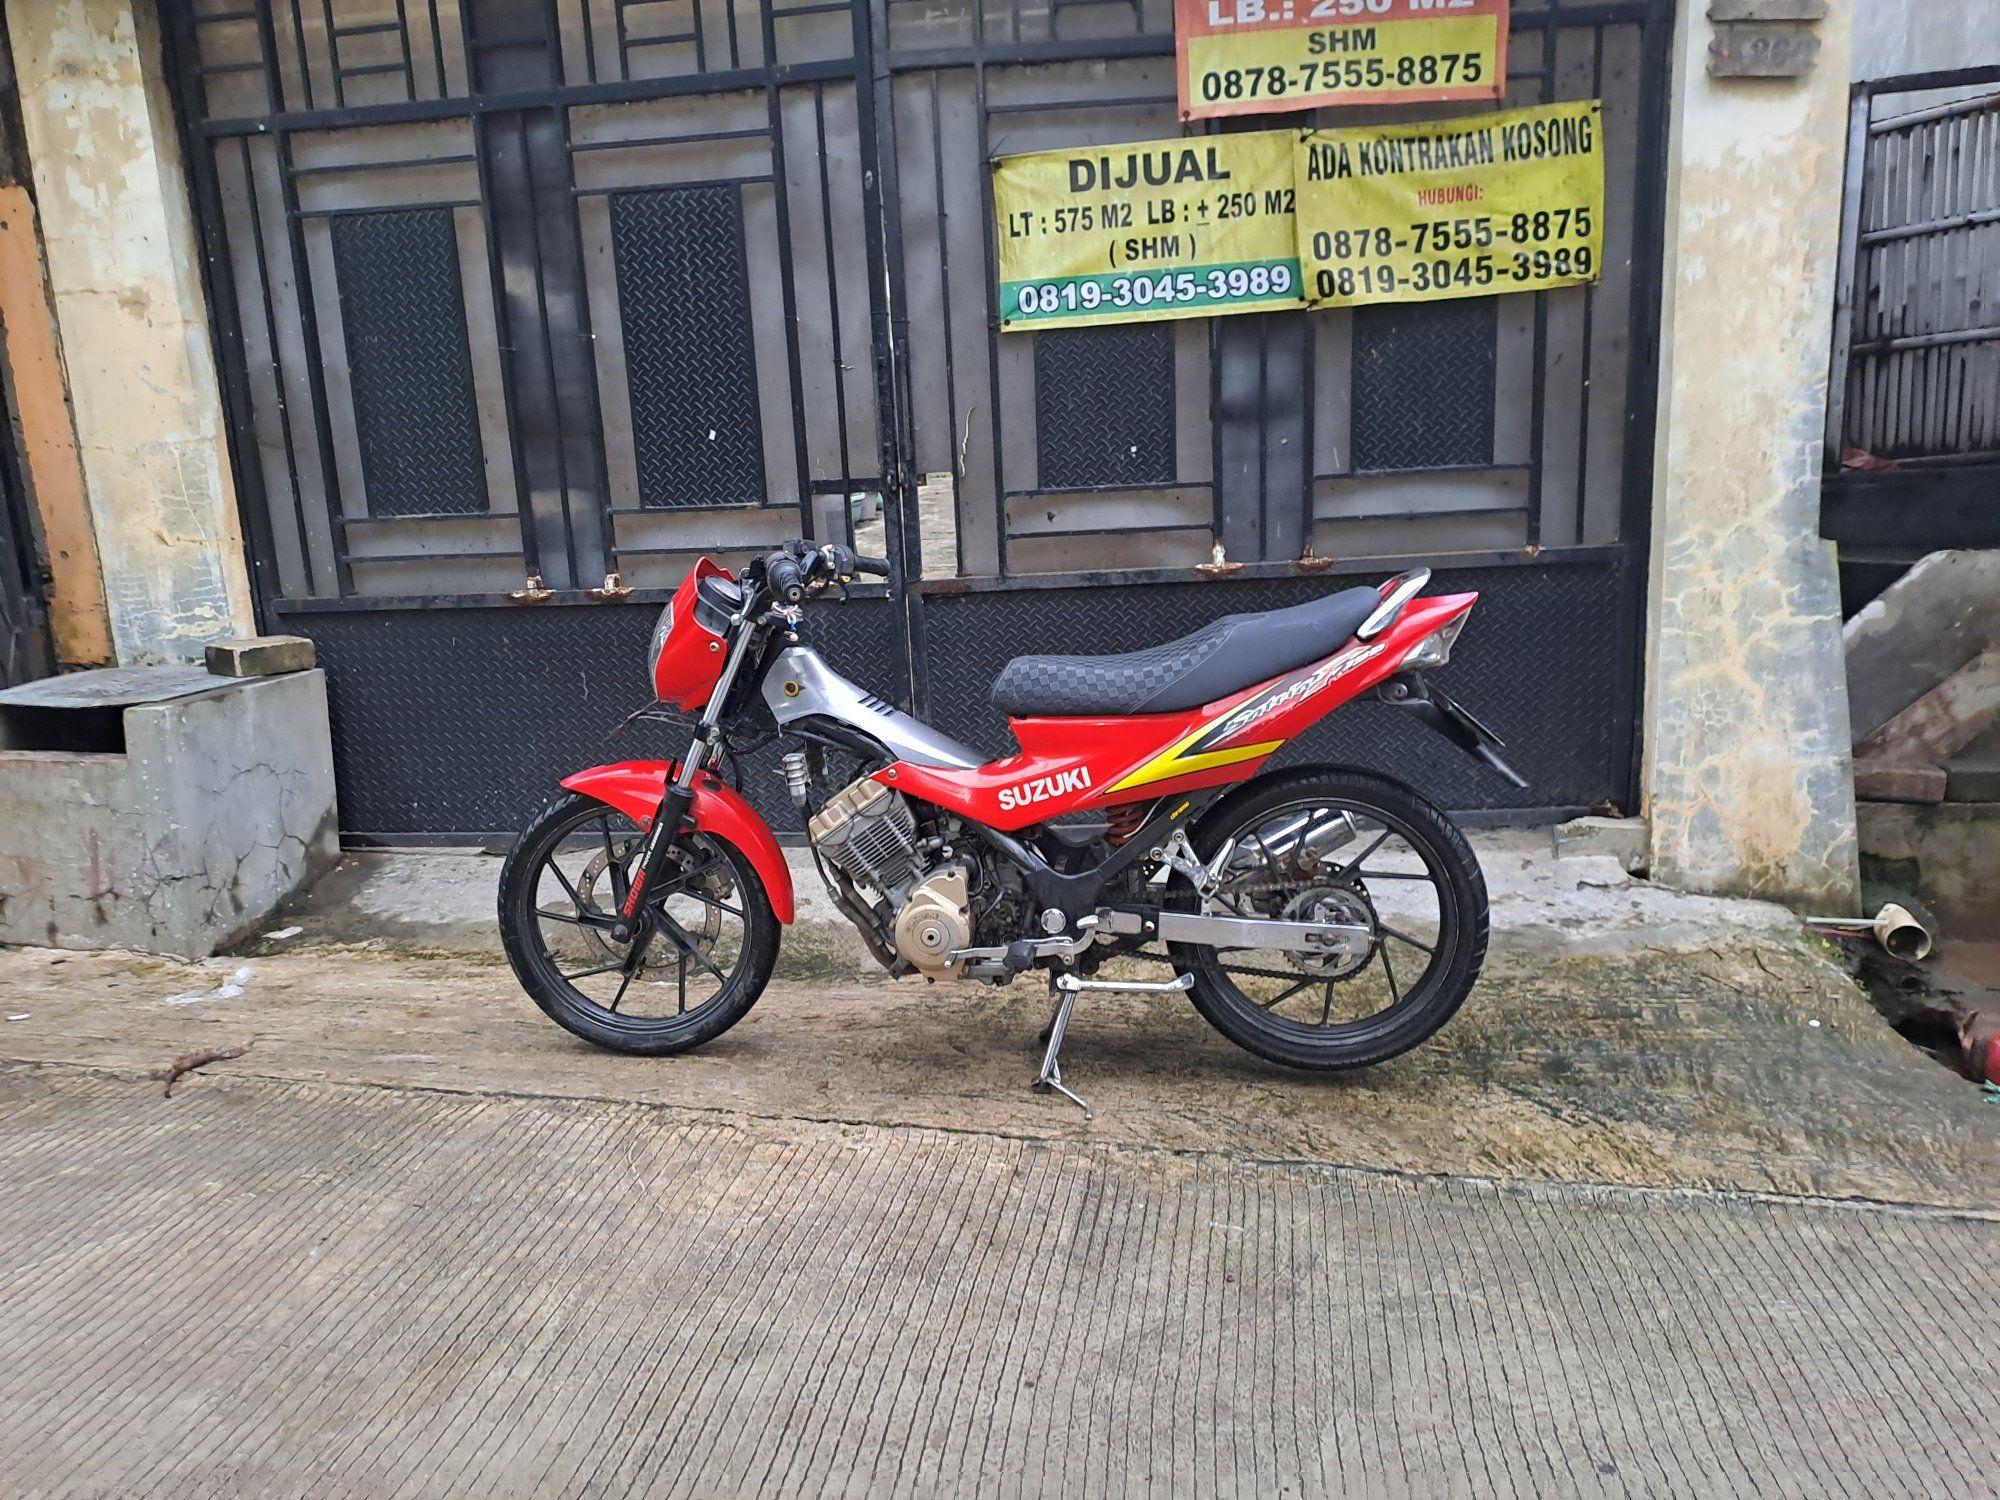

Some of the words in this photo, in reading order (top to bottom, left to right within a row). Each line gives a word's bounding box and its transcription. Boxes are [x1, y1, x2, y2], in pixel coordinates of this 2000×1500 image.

[1308, 27, 1376, 55] SHM
[1202, 53, 1482, 101] 0878-7555-8875
[1069, 147, 1231, 193] DIJUAL
[1308, 142, 1352, 181] ADA
[1358, 128, 1495, 176] KONTRAKAN
[1502, 115, 1593, 162] KOSONG
[1054, 205, 1093, 233] 575
[1101, 202, 1133, 230] M2
[1217, 192, 1257, 219] 250
[1265, 188, 1296, 215] M2
[1417, 184, 1484, 206] HUBUNGI:
[1313, 207, 1591, 261] 0878-7555-8875
[1017, 264, 1292, 315] 0819-3045-3989
[1316, 246, 1592, 298] 0819-3045-3989
[998, 765, 1092, 811] SUZUKI
